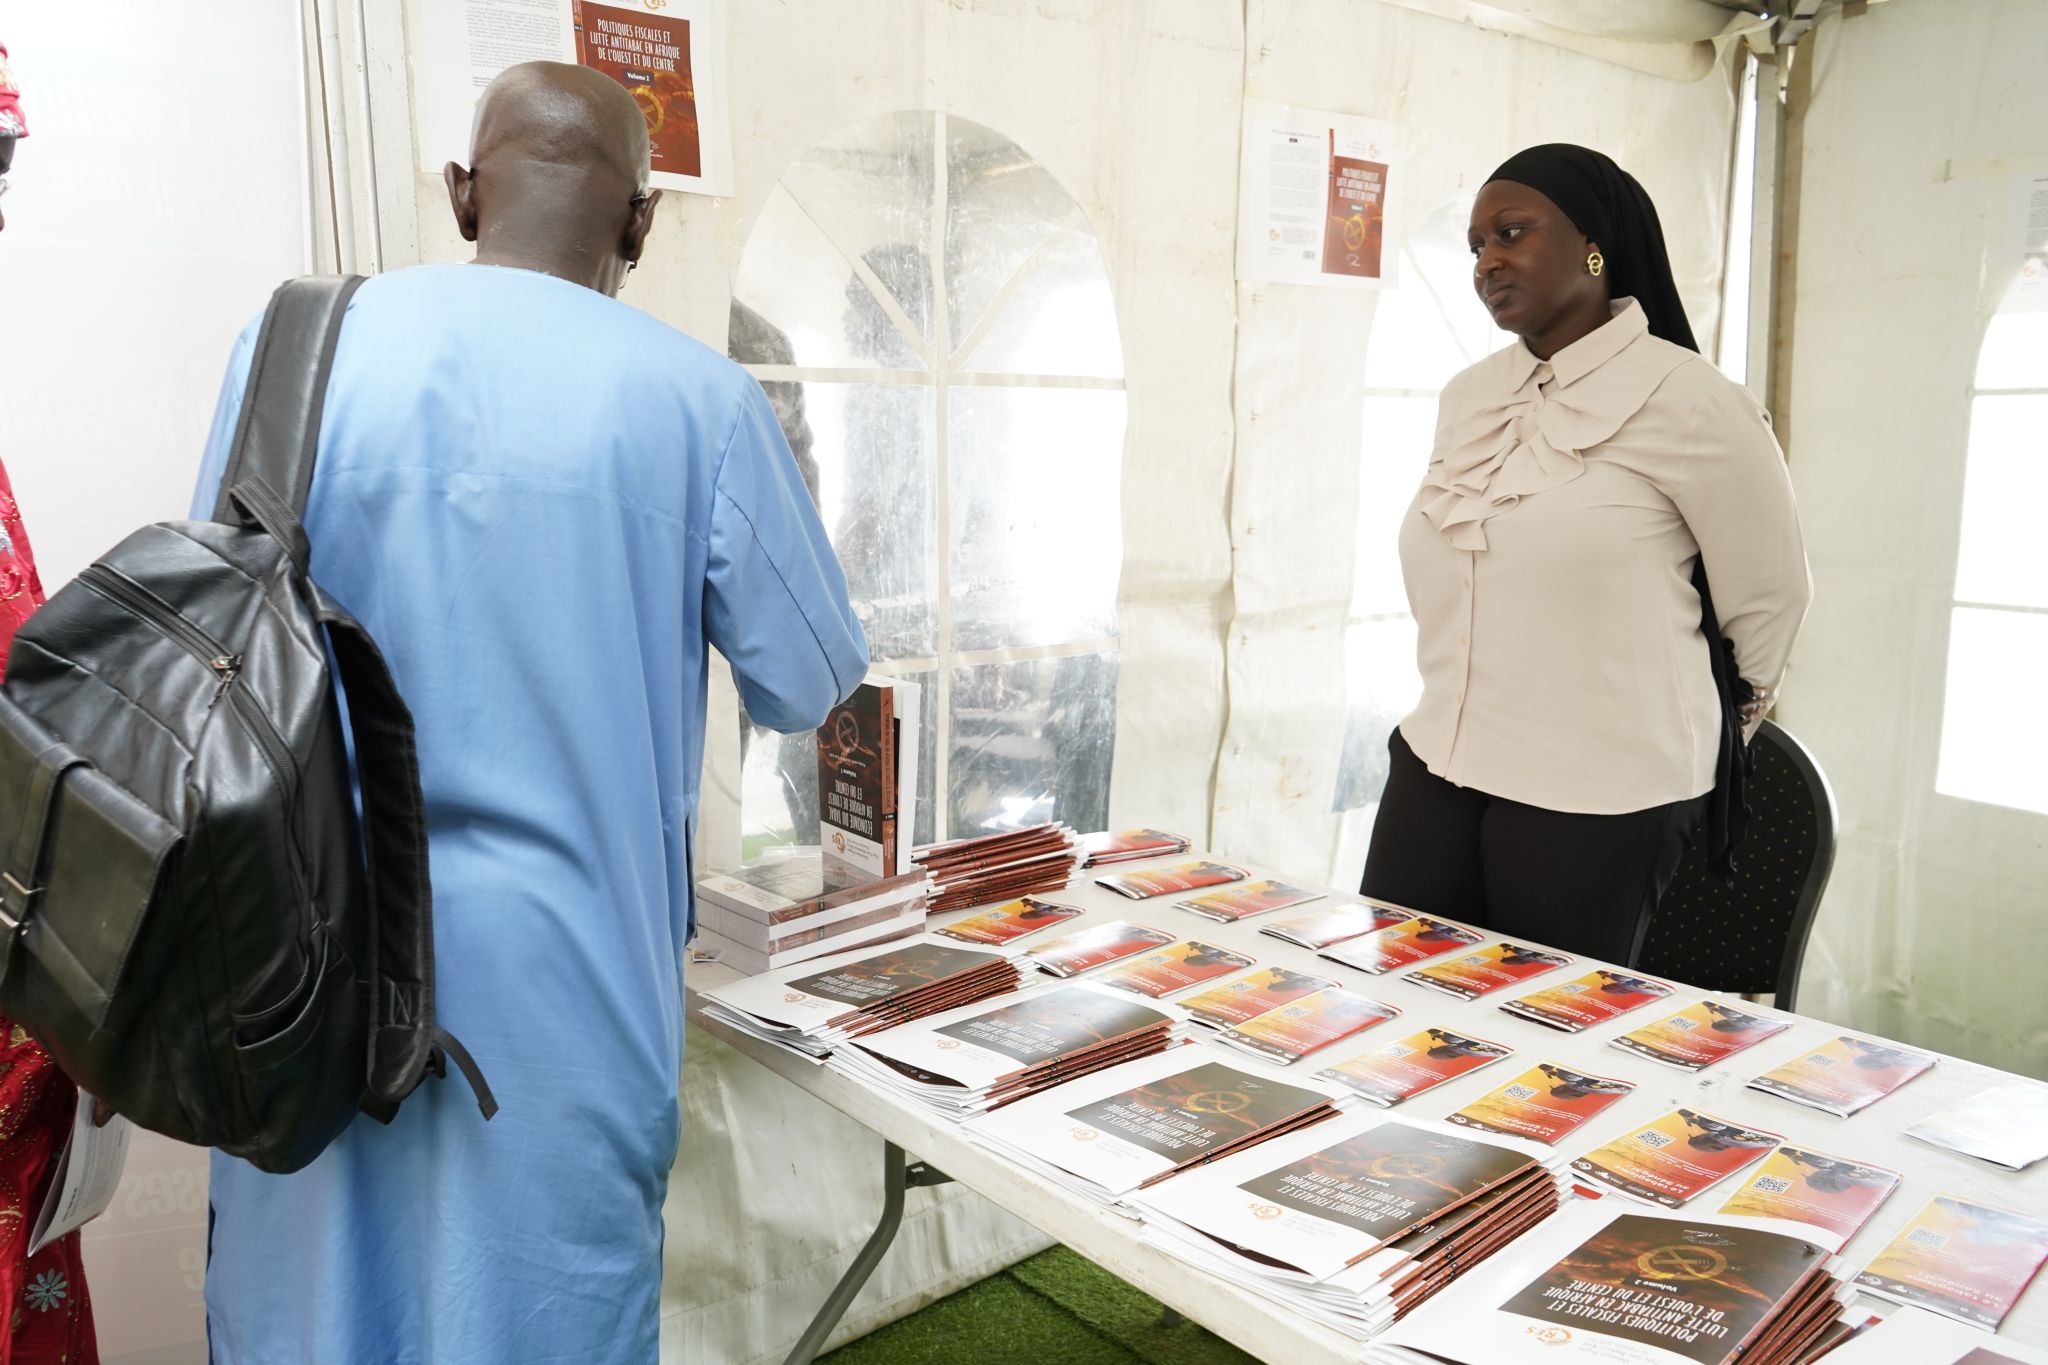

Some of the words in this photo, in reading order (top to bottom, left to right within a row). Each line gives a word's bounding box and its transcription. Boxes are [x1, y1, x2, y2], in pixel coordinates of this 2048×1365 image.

[597, 19, 634, 38] POLITIQUES
[634, 25, 662, 42] FISCALES
[663, 31, 671, 43] ET
[590, 31, 609, 47] LUTTE
[610, 35, 644, 53] ANTITABAC
[644, 41, 653, 54] EN
[655, 44, 681, 60] AFRIQUE
[597, 47, 607, 60] DE
[608, 50, 632, 65] L'OUEST
[633, 54, 641, 66] ET
[642, 55, 652, 68] DU
[652, 57, 675, 72] CENTRE
[627, 71, 645, 82] Volume
[1542, 1286, 1598, 1306] AFRIQUE
[1566, 1279, 1613, 1296] CENTRE
[1611, 1288, 1635, 1301] DU
[1643, 1280, 1678, 1293] Volume
[1546, 1299, 1568, 1312] ET
[1593, 1297, 1614, 1310] EN
[1633, 1291, 1652, 1304] ET
[1649, 1295, 1704, 1317] L'OUEST
[1565, 1303, 1622, 1323] FISCALES
[1614, 1300, 1687, 1325] ANTITABAC
[1702, 1308, 1725, 1322] DE
[1621, 1314, 1700, 1343] POLITIQUES
[1683, 1315, 1729, 1339] LUTTE
